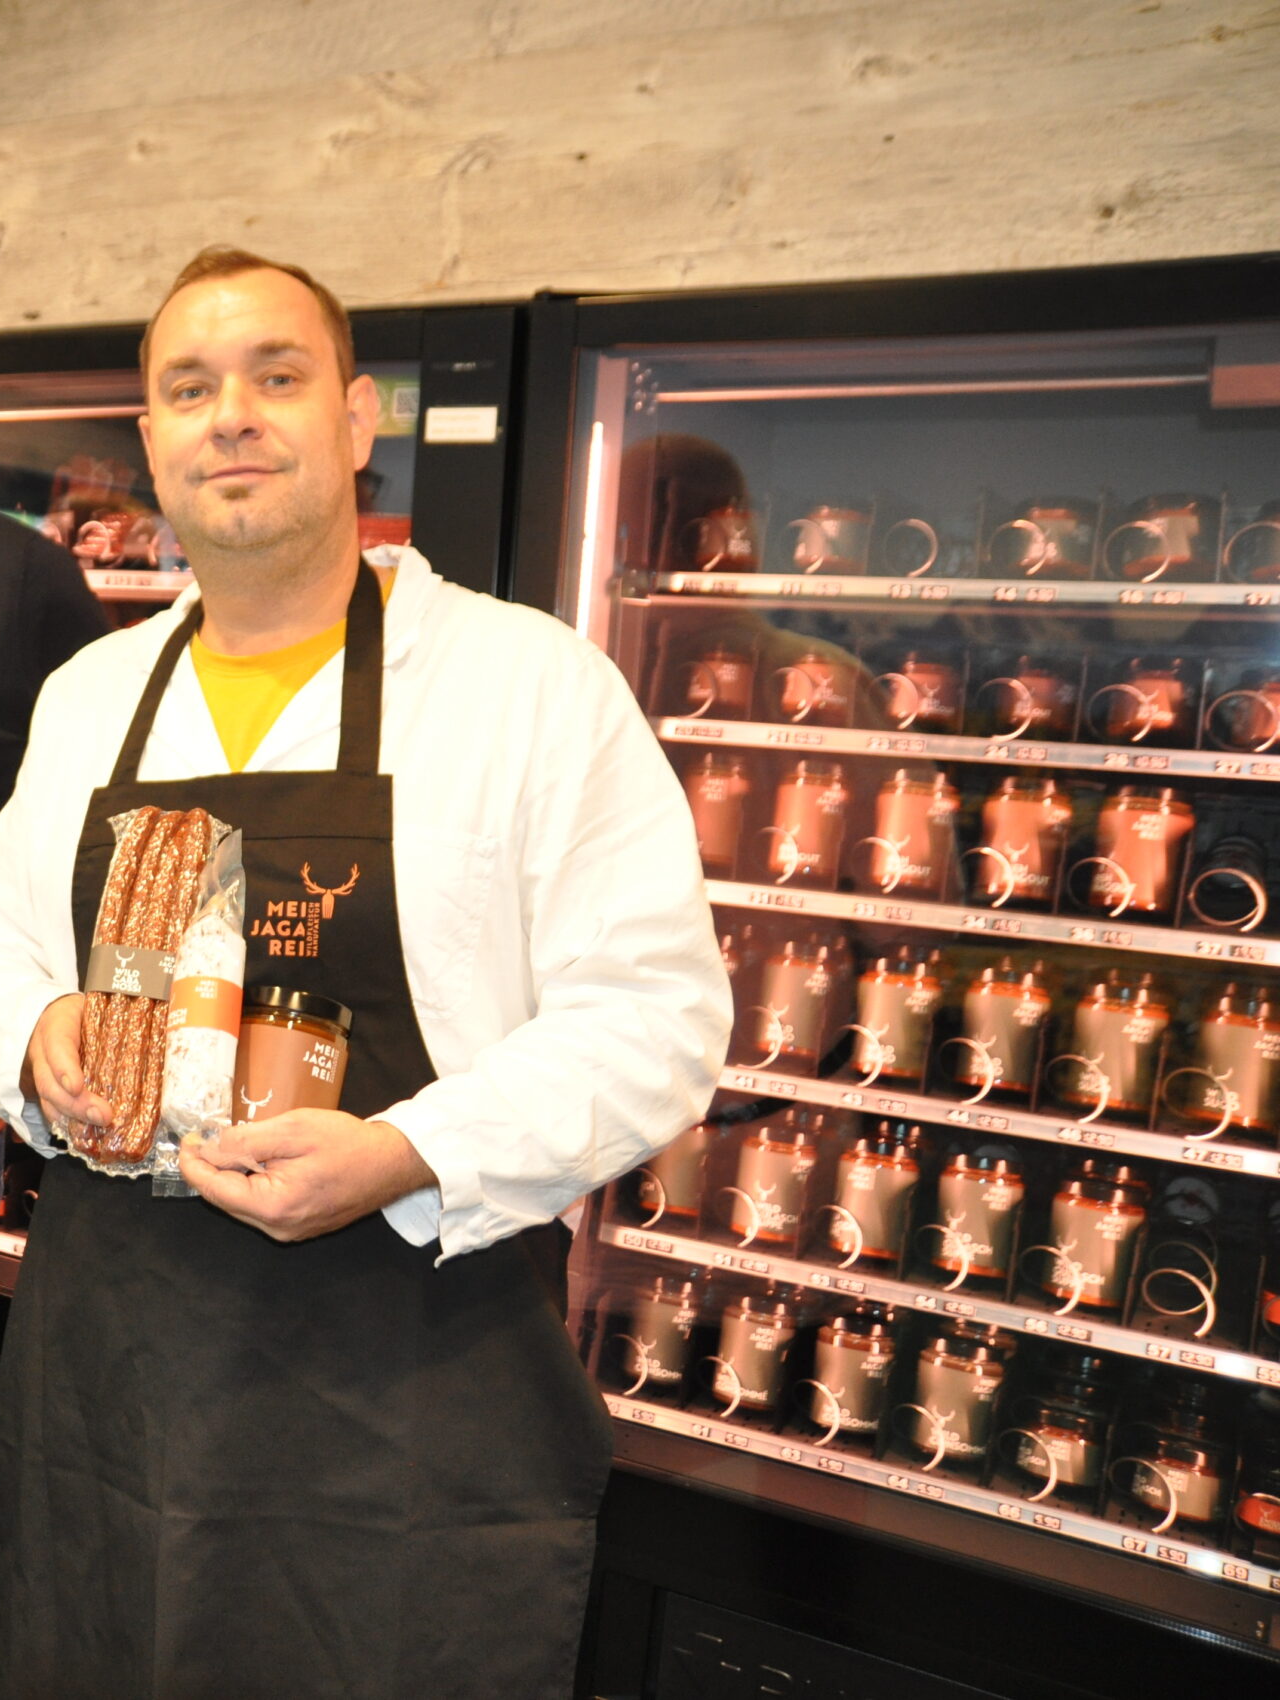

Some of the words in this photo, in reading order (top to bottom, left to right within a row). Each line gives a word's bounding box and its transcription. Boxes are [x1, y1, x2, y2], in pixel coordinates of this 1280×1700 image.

[267, 901, 306, 918] MEI
[251, 919, 306, 937] JAGA
[269, 939, 305, 957] REI
[315, 1042, 334, 1057] MEI
[303, 1051, 333, 1069] JAGA
[311, 1066, 331, 1082] REI
[1146, 1343, 1171, 1358] 57
[1122, 1536, 1146, 1552] 67
[1223, 1563, 1249, 1580] 69
